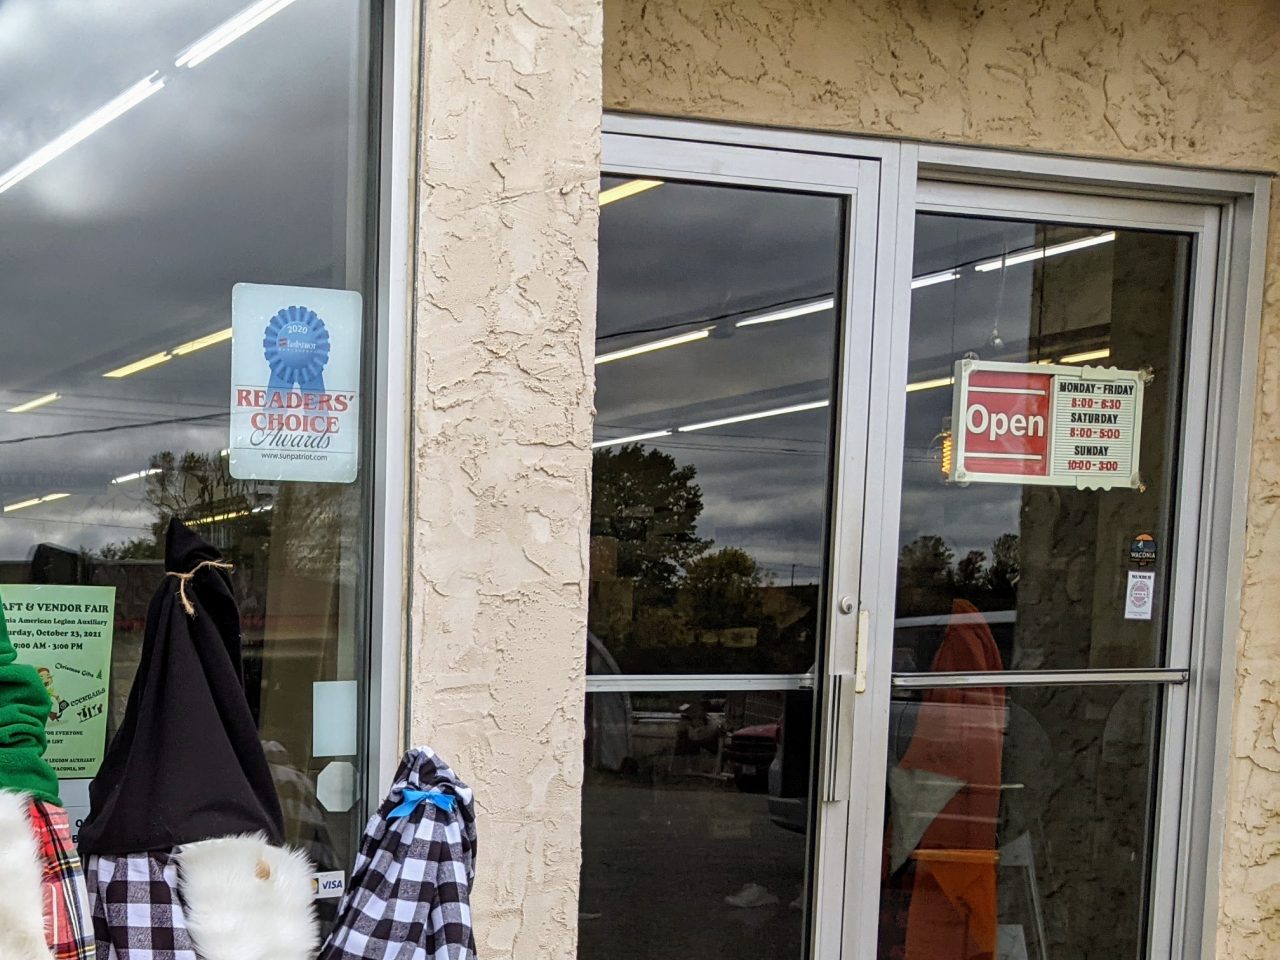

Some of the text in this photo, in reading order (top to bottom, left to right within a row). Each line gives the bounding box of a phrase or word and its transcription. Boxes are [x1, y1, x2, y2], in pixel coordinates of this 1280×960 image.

[287, 324, 308, 334] 2020
[1060, 382, 1096, 394] MONDAY
[1103, 384, 1134, 395] FRIDAY
[237, 389, 355, 412] READERS'
[1071, 397, 1093, 408] 8:00
[250, 412, 340, 434] CHOICE
[966, 403, 1045, 441] Open
[1071, 412, 1119, 424] SATURDAY
[250, 423, 331, 449] Awards
[1070, 427, 1092, 438] 8:00
[1099, 428, 1120, 439] 5:00
[1074, 445, 1109, 456] SUNDAY
[261, 451, 328, 462] www.sunpatriot.com
[1068, 459, 1091, 470] 10:00
[1099, 460, 1118, 471] 3:00
[2, 602, 109, 613] AFT & VENDOR FAIR
[53, 618, 76, 626] Legion
[8, 629, 35, 637] urday,
[36, 629, 69, 637] October
[13, 642, 31, 650] 9:00
[32, 642, 47, 650] AM
[52, 642, 69, 650] 3:00
[70, 642, 83, 650] PM
[322, 880, 343, 890] VISA
